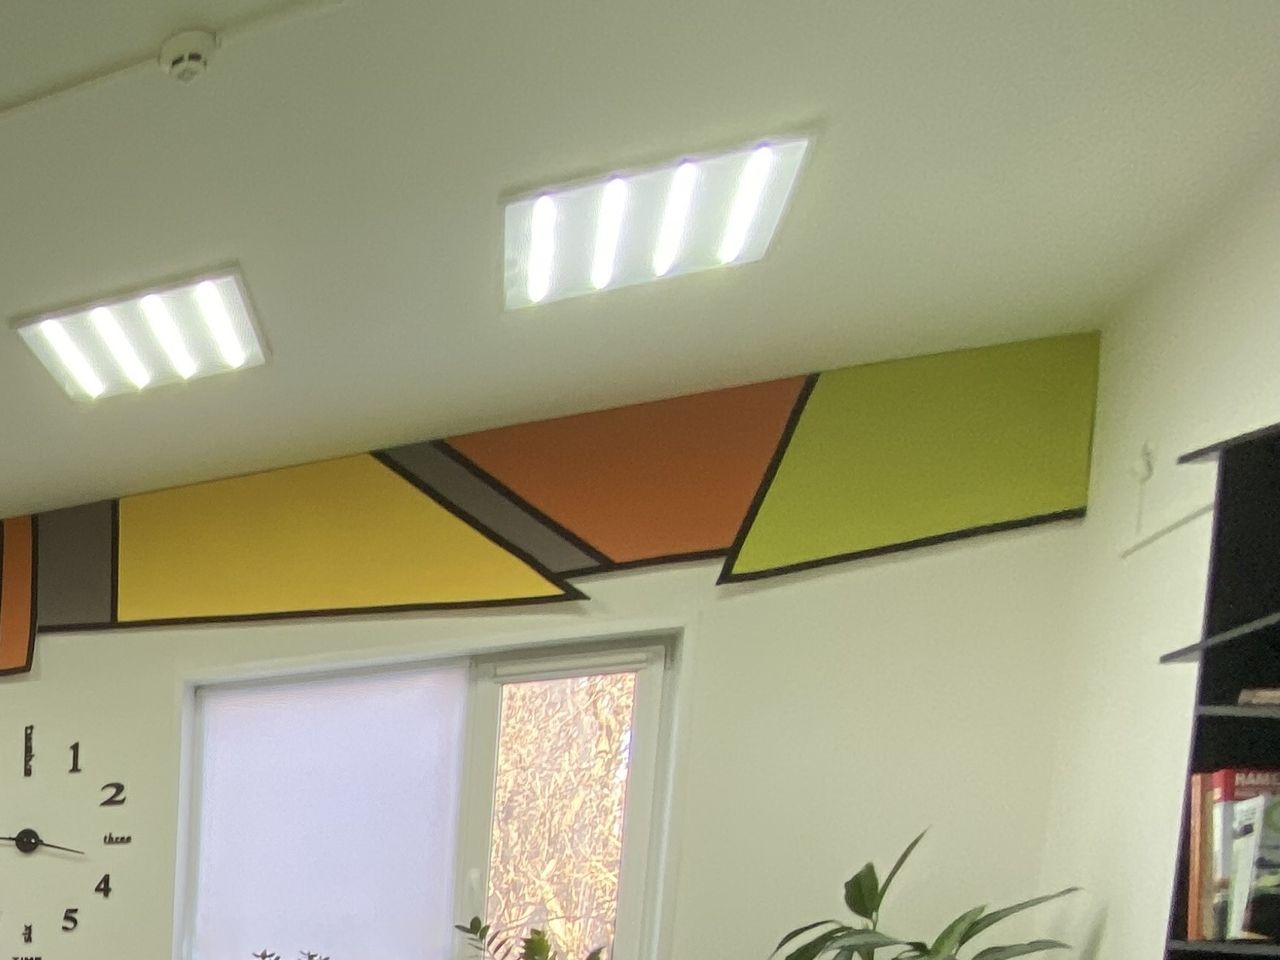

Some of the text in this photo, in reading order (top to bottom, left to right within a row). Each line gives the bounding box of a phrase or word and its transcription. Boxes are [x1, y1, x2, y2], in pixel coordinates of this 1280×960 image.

[68, 741, 82, 773] 1
[99, 782, 126, 807] 2
[103, 832, 132, 845] three
[94, 873, 112, 898] 4
[61, 907, 79, 931] 5
